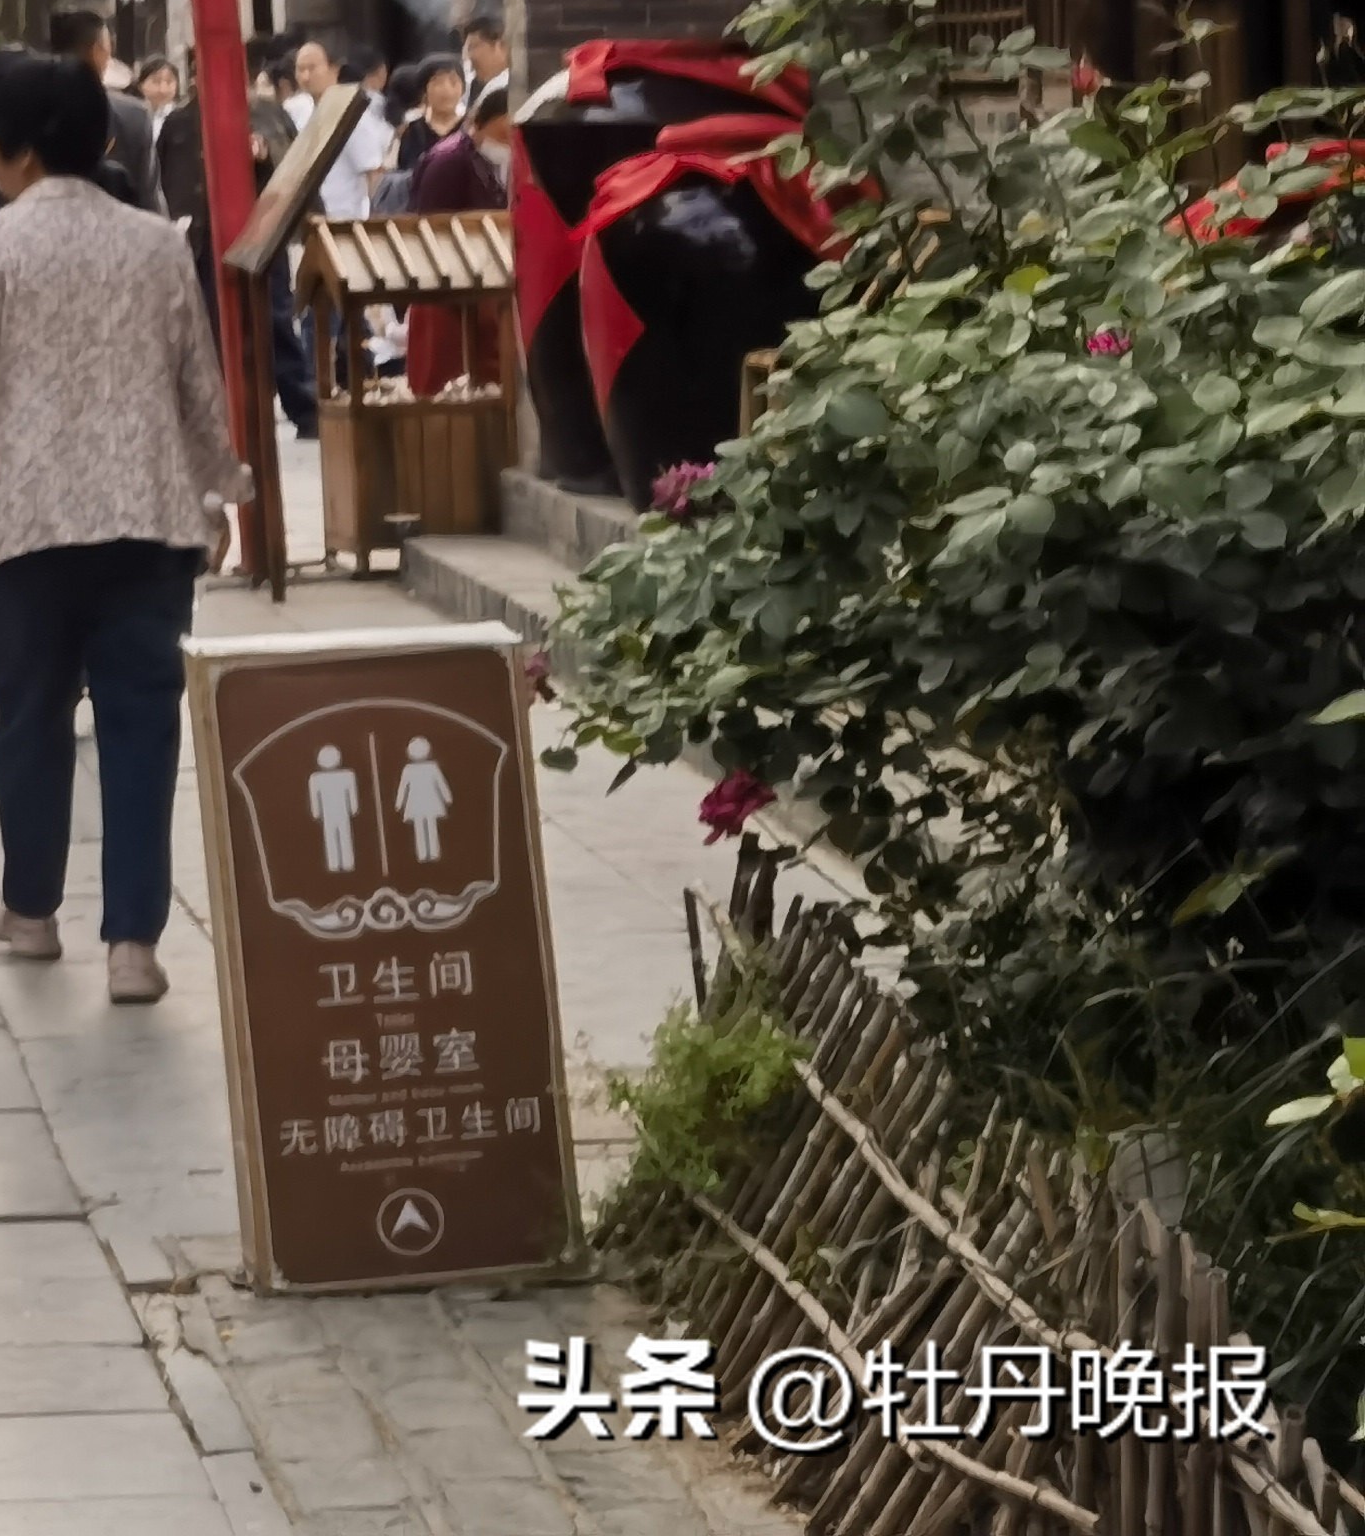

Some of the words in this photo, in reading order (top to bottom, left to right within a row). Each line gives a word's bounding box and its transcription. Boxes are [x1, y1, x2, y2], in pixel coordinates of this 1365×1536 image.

[316, 950, 473, 1008] 卫生间
[321, 1027, 481, 1084] 母婴室
[279, 1096, 542, 1156] 无障碍卫生间
